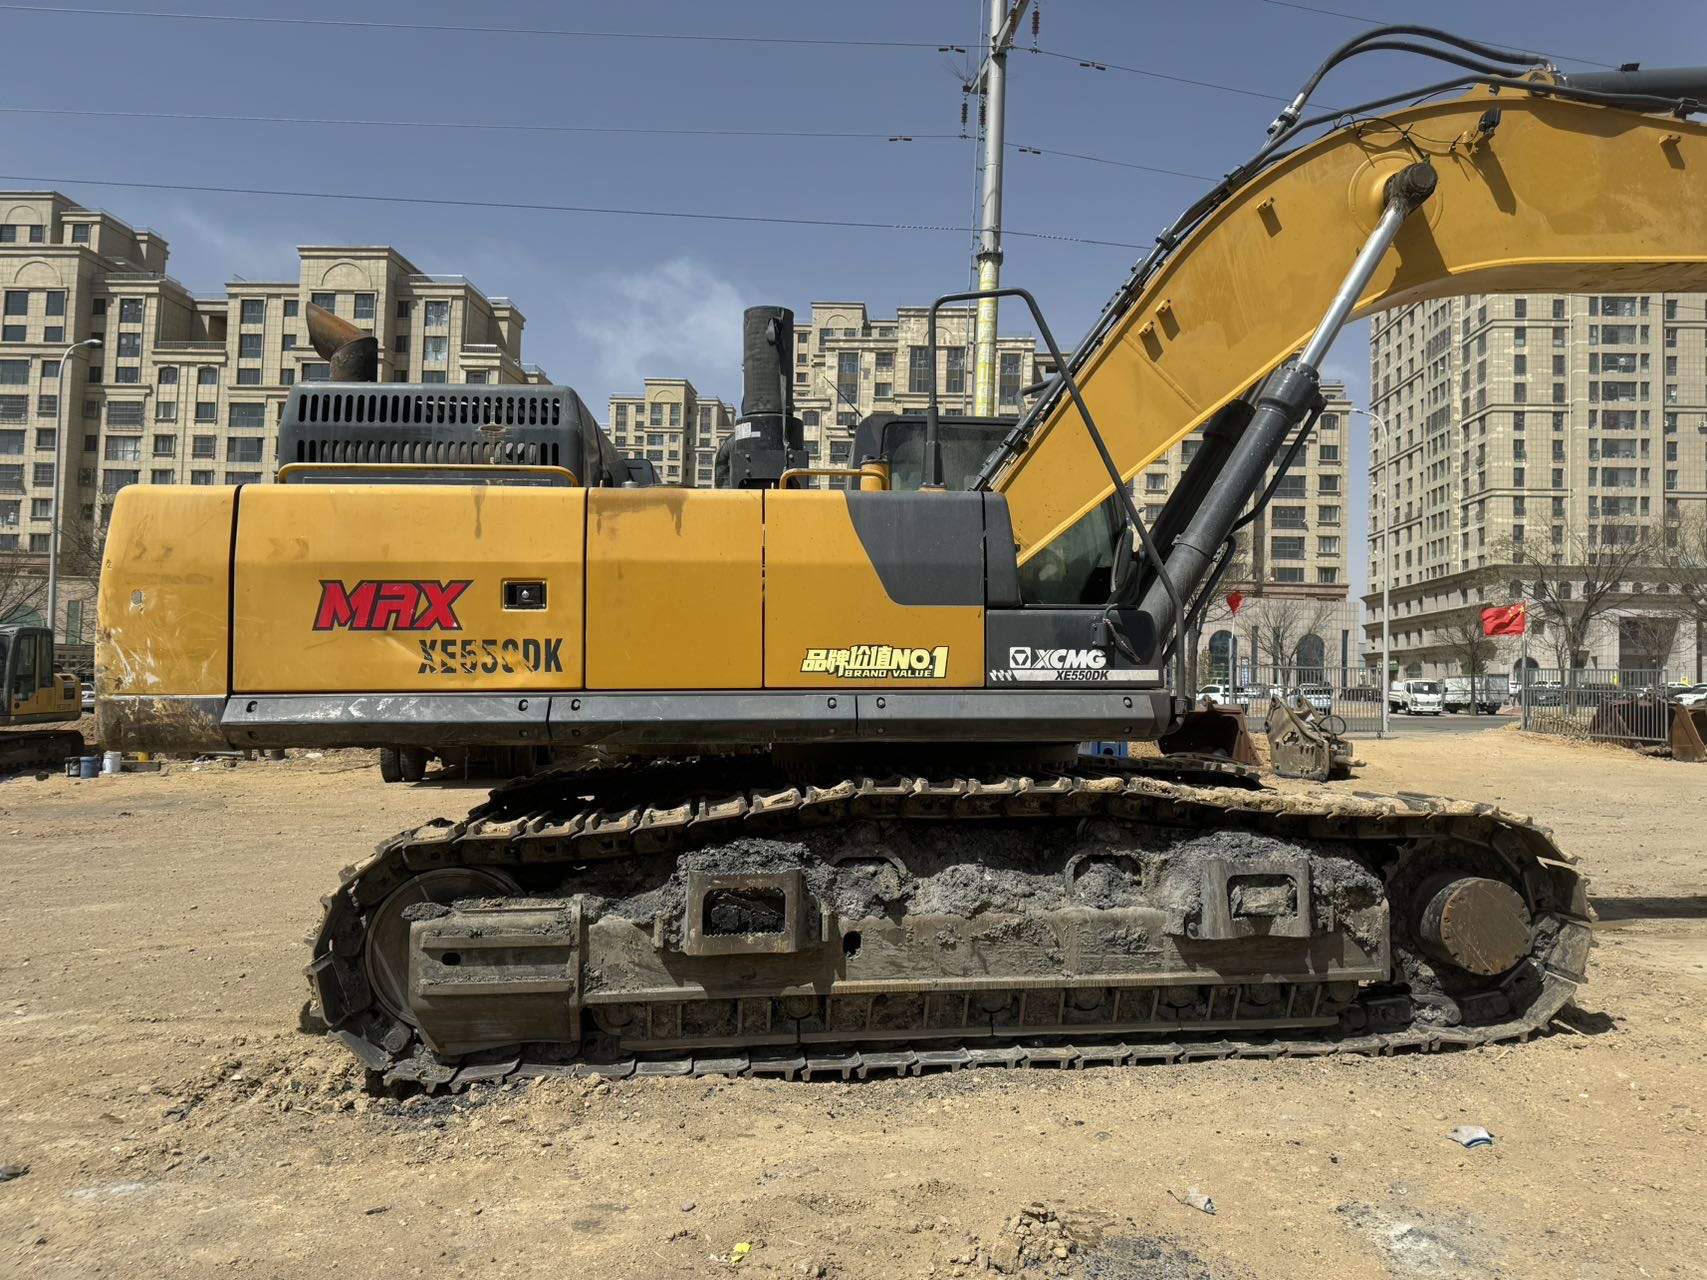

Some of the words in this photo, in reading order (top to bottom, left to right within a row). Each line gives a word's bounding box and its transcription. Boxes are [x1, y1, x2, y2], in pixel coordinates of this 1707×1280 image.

[312, 579, 474, 631] MAX
[1031, 649, 1106, 669] XCMG
[845, 669, 887, 678] BRAND
[892, 669, 932, 678] VALUE
[1055, 670, 1109, 681] XE550DK
